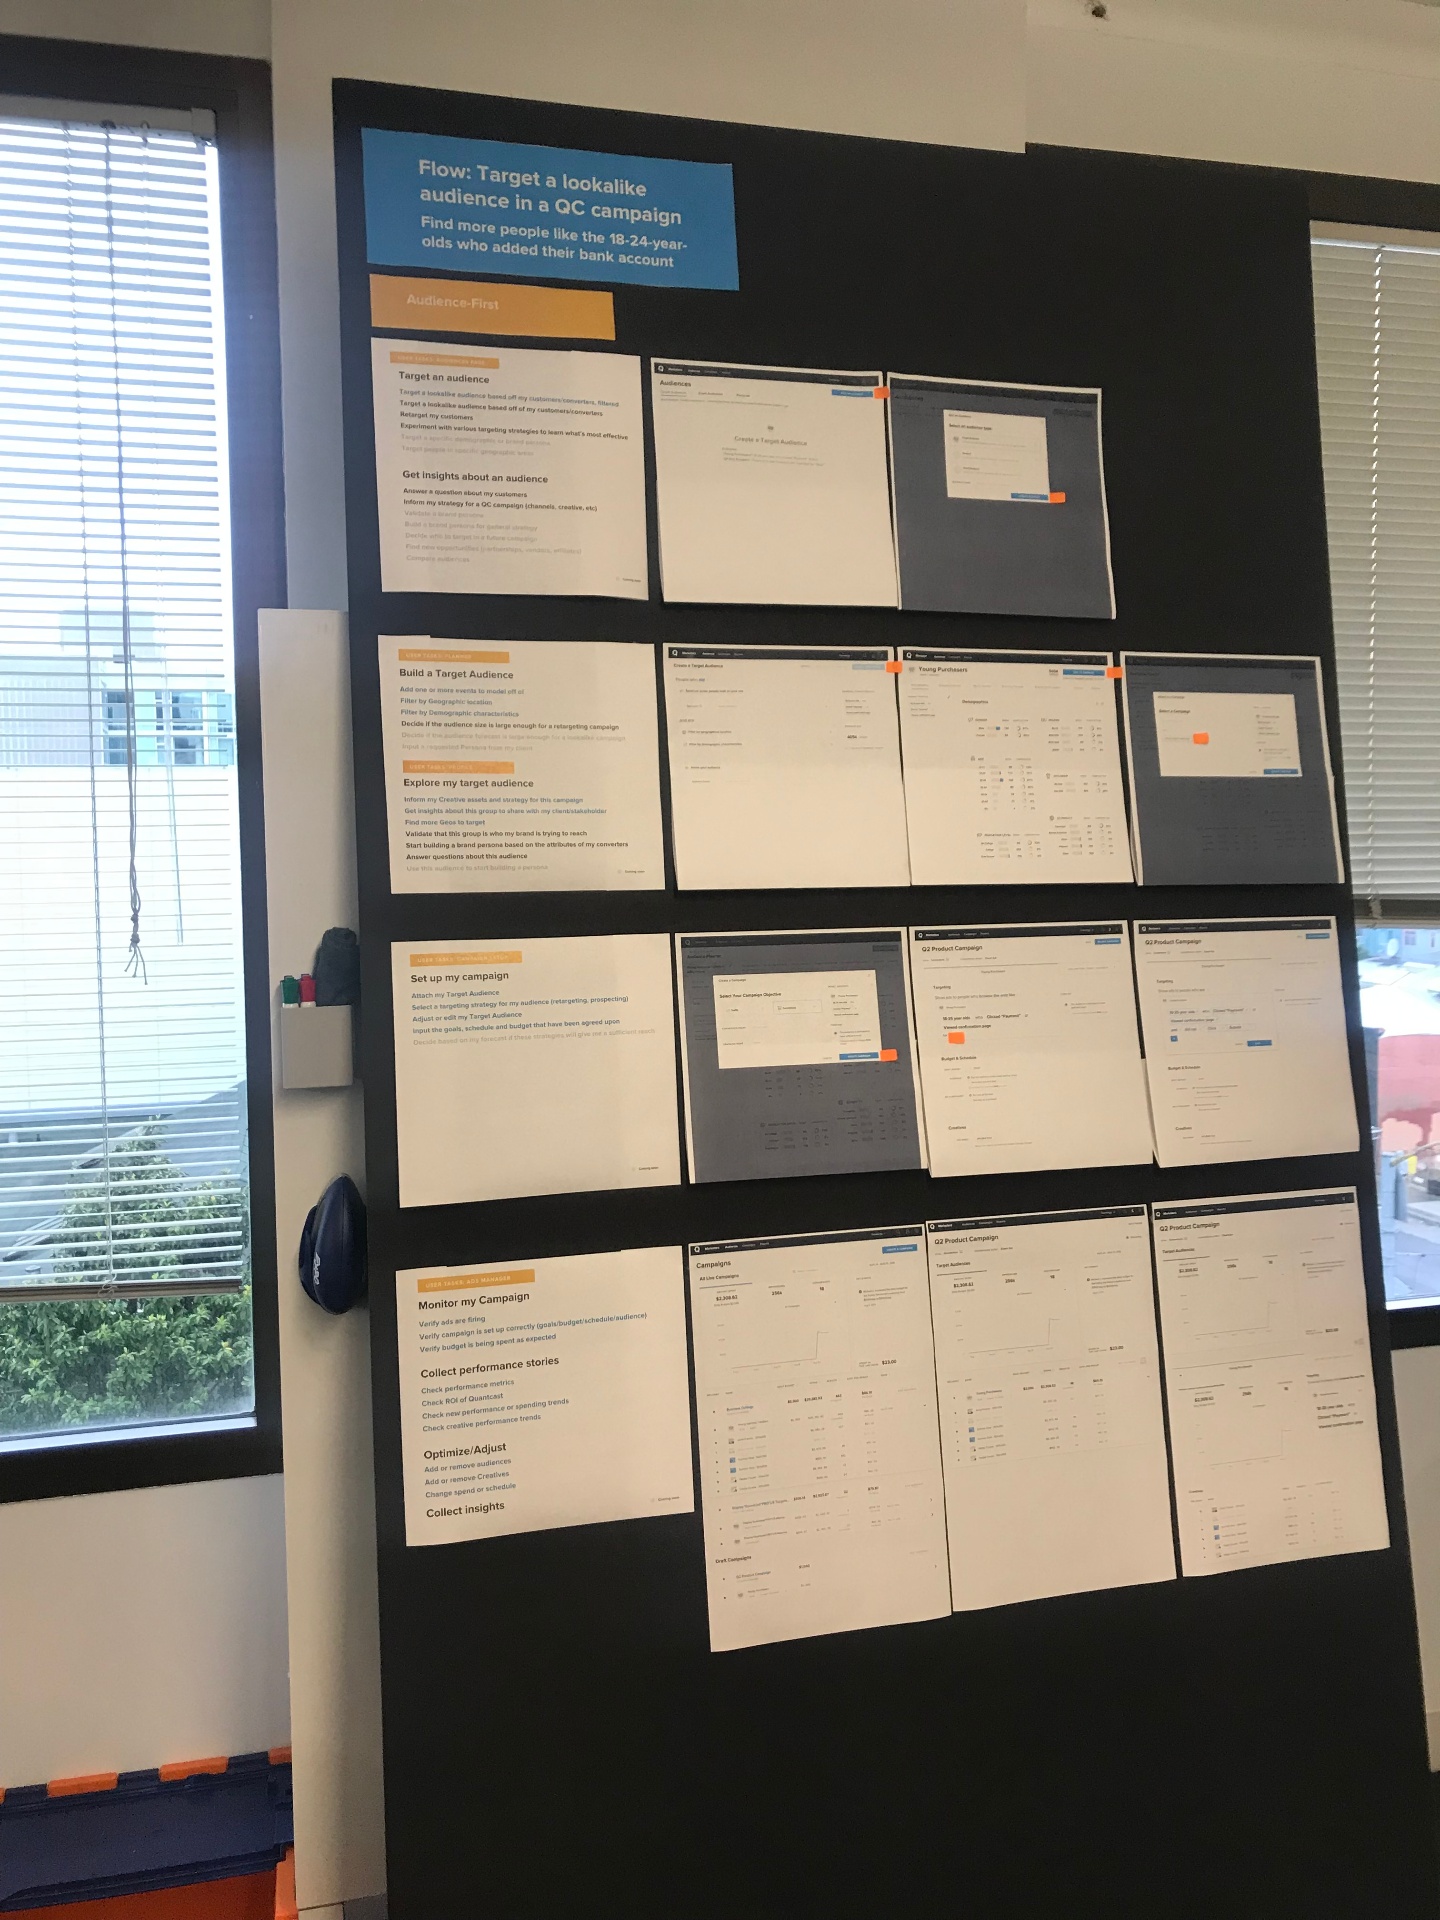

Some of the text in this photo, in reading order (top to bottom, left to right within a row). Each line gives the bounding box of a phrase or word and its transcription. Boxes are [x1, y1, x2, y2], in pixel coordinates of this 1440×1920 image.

[418, 159, 647, 197] Flow: Target a lookalike
[420, 188, 682, 227] audience in a QC campaign
[421, 215, 687, 251] Find more people like the 18-24-year-
[421, 235, 674, 268] olds who added their bank account
[406, 294, 499, 311] Audience-First
[399, 371, 430, 382] Target
[446, 374, 490, 384] audience
[402, 470, 420, 479] Get
[422, 470, 460, 482] insights
[461, 472, 489, 482] about
[505, 474, 549, 484] audience
[399, 668, 424, 677] Build
[435, 669, 467, 680] Target
[469, 670, 514, 679] Audience
[403, 778, 534, 789] Explore my target audience
[410, 972, 509, 984] Set up my campaign
[418, 1292, 530, 1310] Monitor my Campaign
[420, 1356, 560, 1379] Collect performance stories
[423, 1442, 507, 1460] Optimize/Adjust
[426, 1502, 505, 1518] Collect insights
